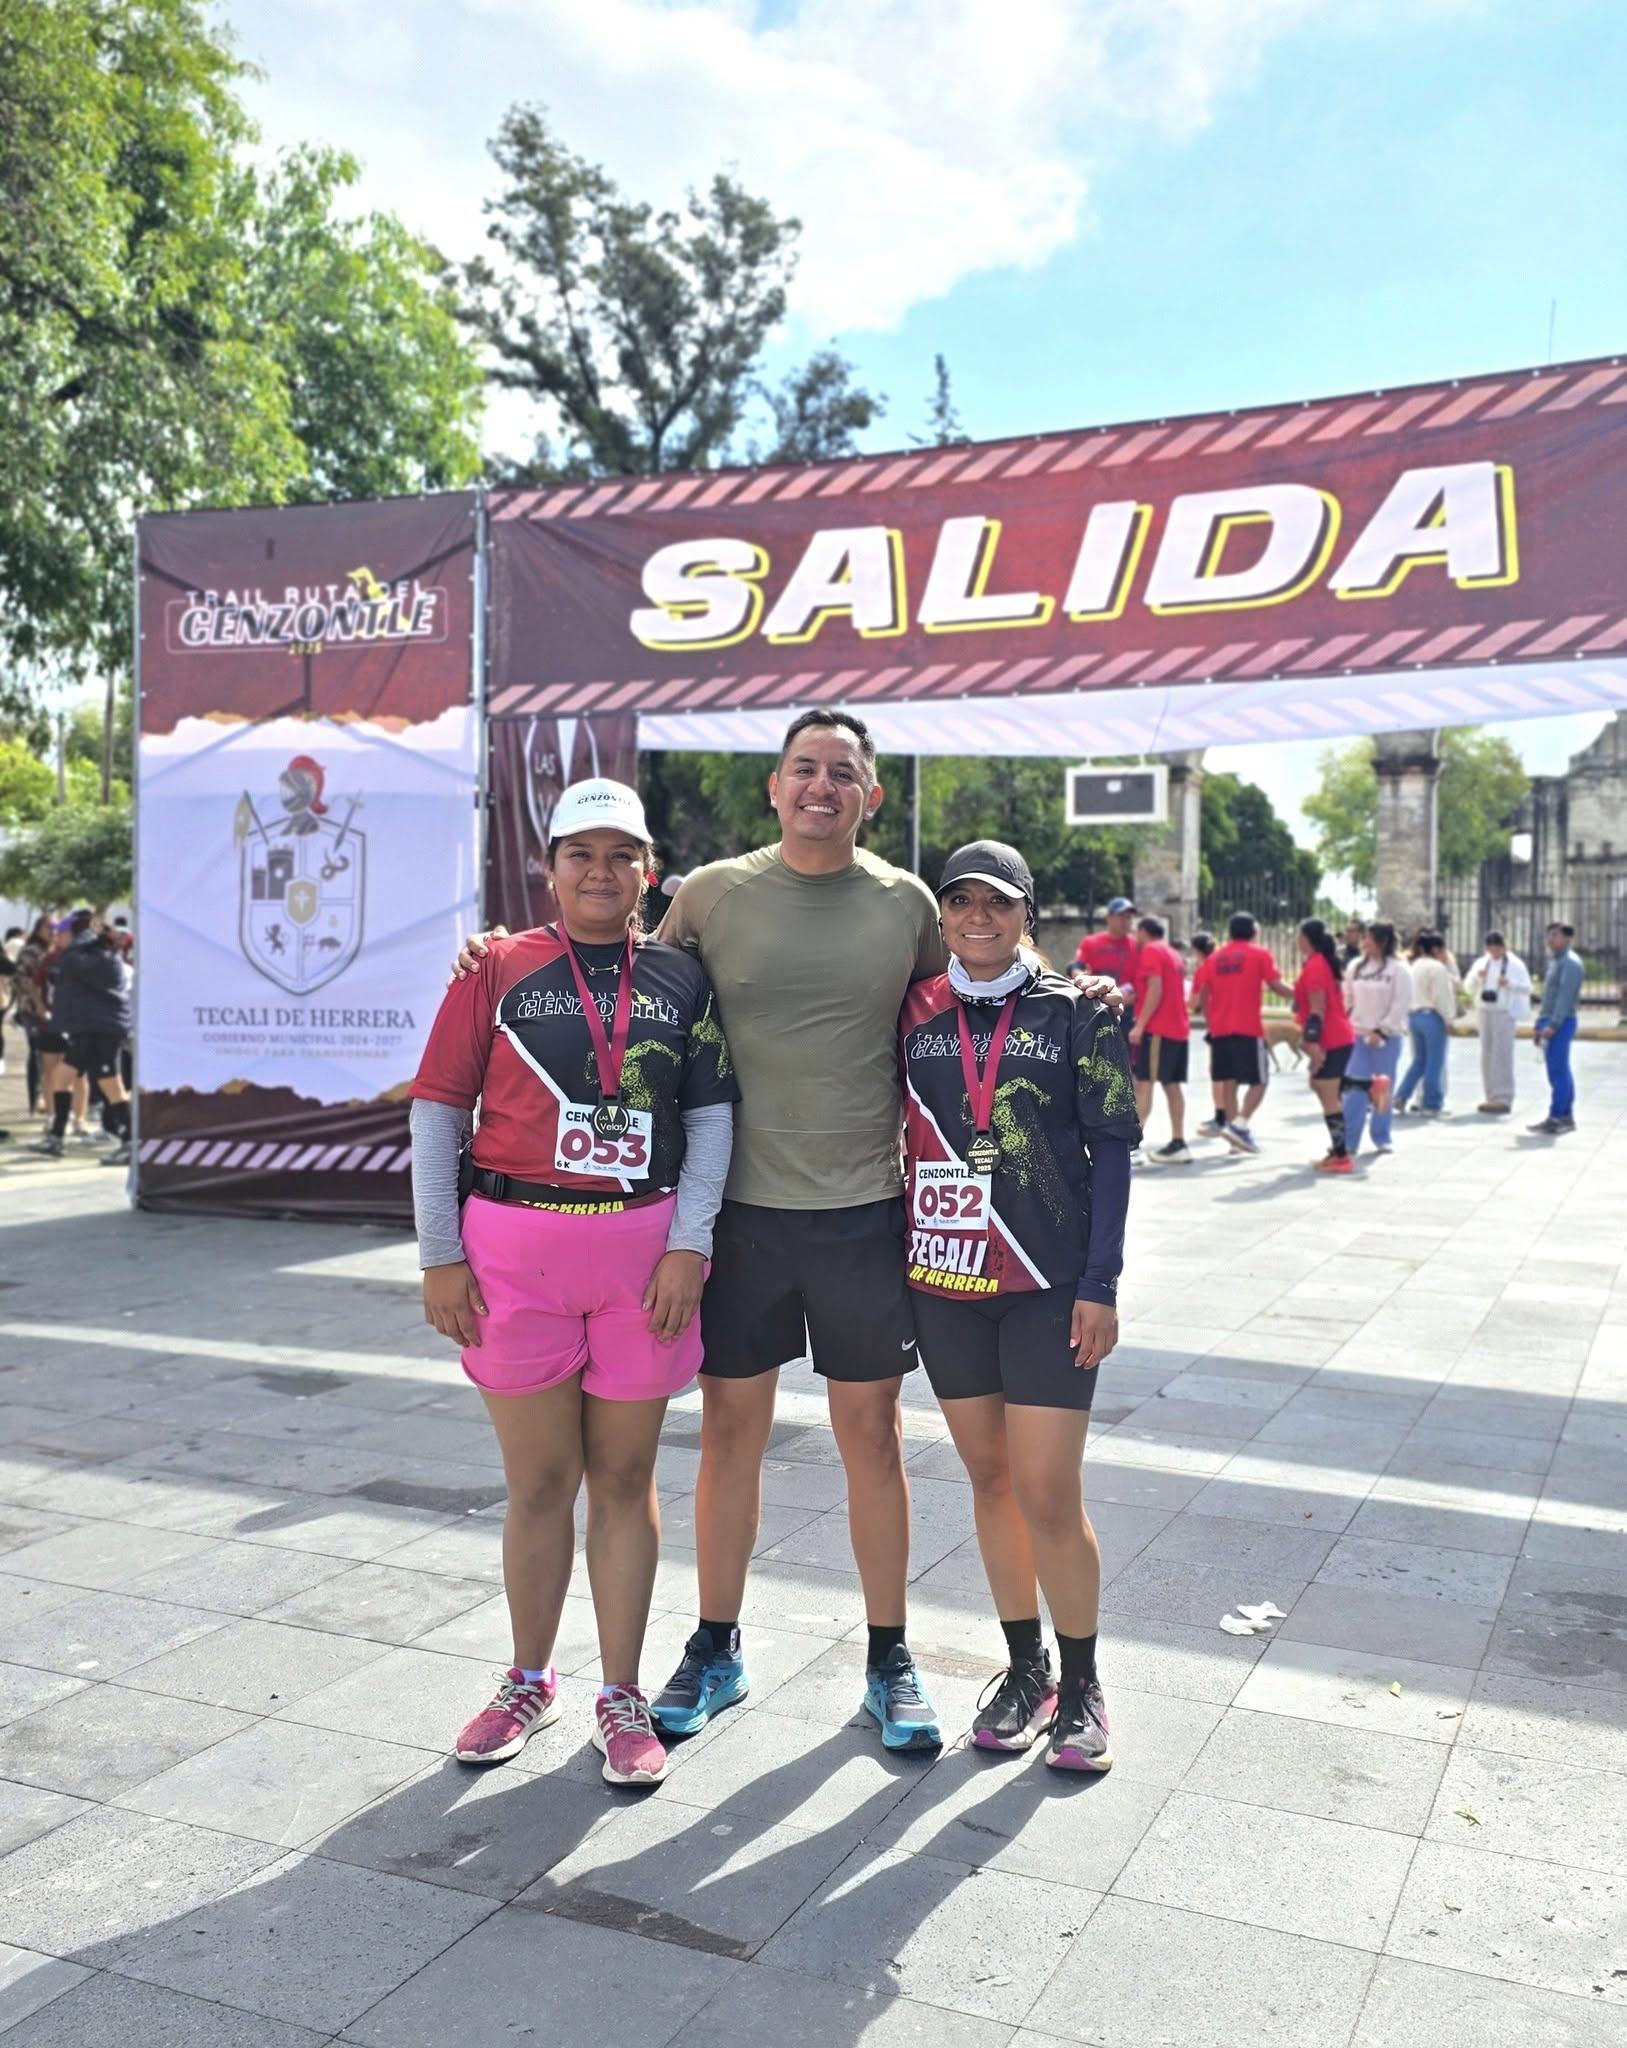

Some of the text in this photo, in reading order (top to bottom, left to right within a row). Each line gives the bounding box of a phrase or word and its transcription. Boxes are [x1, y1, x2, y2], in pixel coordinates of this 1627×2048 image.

[630, 460, 1519, 651] SALIDA
[185, 588, 265, 606] TRAIL
[285, 585, 359, 604] RUTA
[179, 594, 437, 646] CENZONTLE
[534, 752, 556, 776] LAS
[520, 991, 572, 1000] TRAIL
[194, 1007, 415, 1029] TECALI DE HERRERA
[517, 998, 679, 1026] CENZOTLE
[203, 1032, 265, 1043] GOBIERNO
[270, 1033, 336, 1045] MUNICIPAL
[916, 1032, 957, 1041] TRAIL
[911, 1039, 1061, 1063] CENONTLE
[565, 1111, 639, 1128] CENLE
[600, 1123, 623, 1131] Velas
[560, 1128, 647, 1168] 053
[968, 1149, 1000, 1157] CENZONTLE
[918, 1168, 975, 1179] CENZONTLE
[918, 1184, 983, 1218] 052
[908, 1230, 988, 1276] TECALI
[925, 1268, 999, 1293] HERRERA
